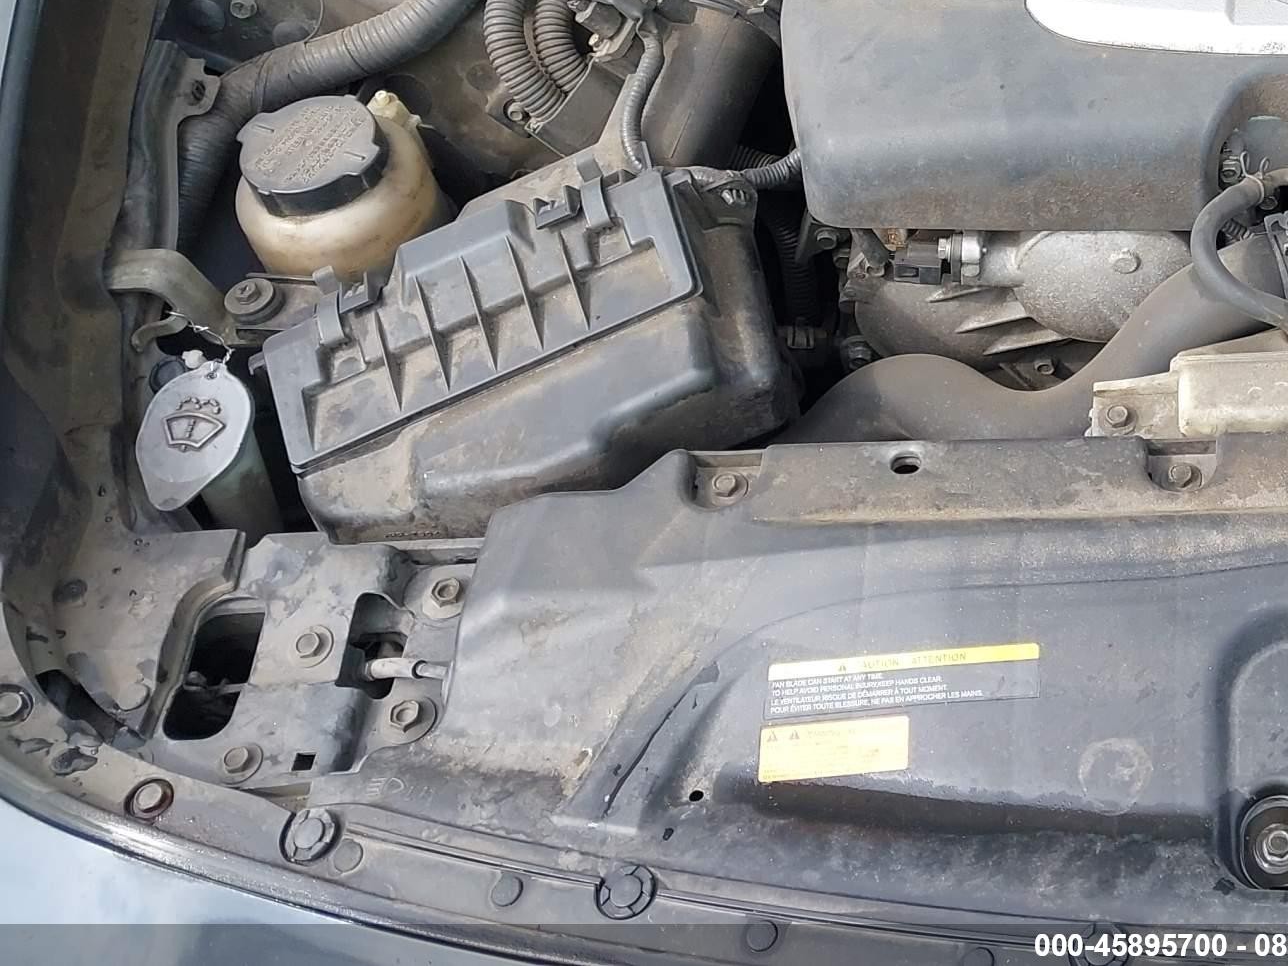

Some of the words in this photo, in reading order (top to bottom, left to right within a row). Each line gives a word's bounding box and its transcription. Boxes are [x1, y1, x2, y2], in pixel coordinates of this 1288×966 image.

[857, 657, 899, 669] AUTION
[911, 650, 968, 665] ATTENTION
[772, 689, 781, 697] TO
[782, 688, 798, 696] HELP
[798, 686, 819, 694] AVOID
[820, 684, 854, 693] PERSONAL
[895, 677, 918, 686] HANDS
[807, 678, 822, 686] CAN
[843, 675, 852, 683] AT
[852, 674, 866, 682] ANY
[770, 705, 789, 714] POUR
[813, 701, 834, 710] TOUTE
[895, 695, 905, 703] EN
[947, 691, 960, 699] LES
[771, 699, 780, 707] LE
[899, 685, 917, 694] TOUT
